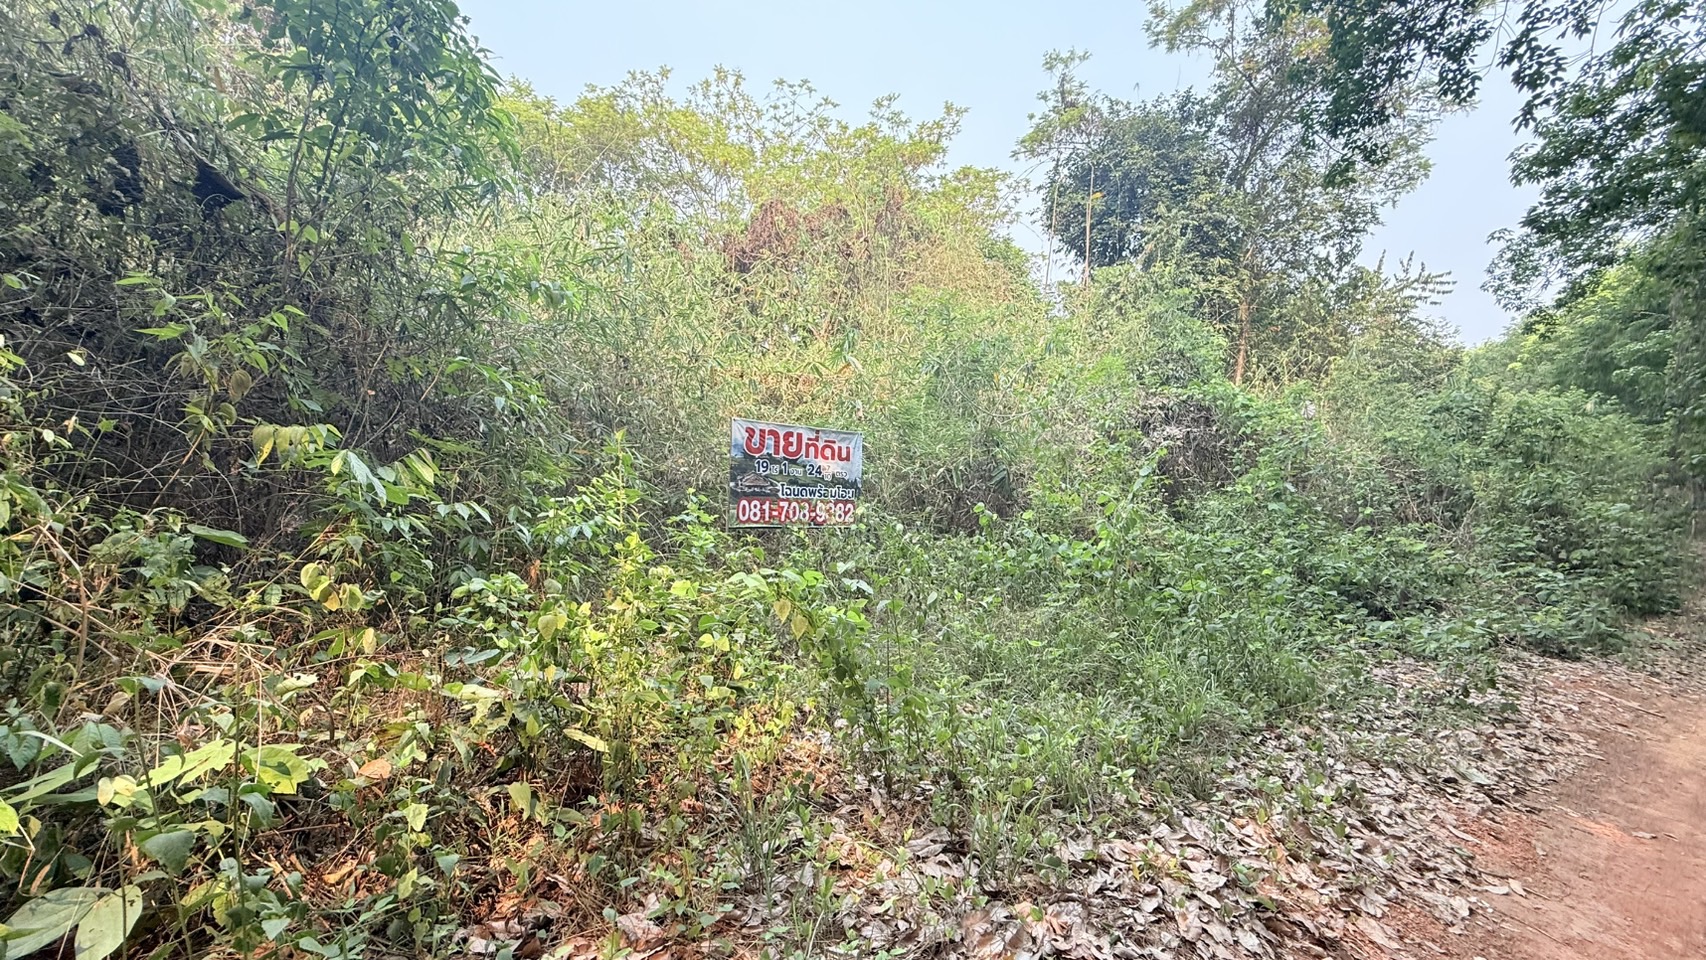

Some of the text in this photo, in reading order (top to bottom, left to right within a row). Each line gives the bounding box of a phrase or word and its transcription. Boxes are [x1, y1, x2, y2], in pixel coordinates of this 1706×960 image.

[744, 427, 851, 462] ขายที่ดิน
[755, 460, 770, 473] 19
[781, 461, 788, 475] 1
[807, 463, 823, 477] 24
